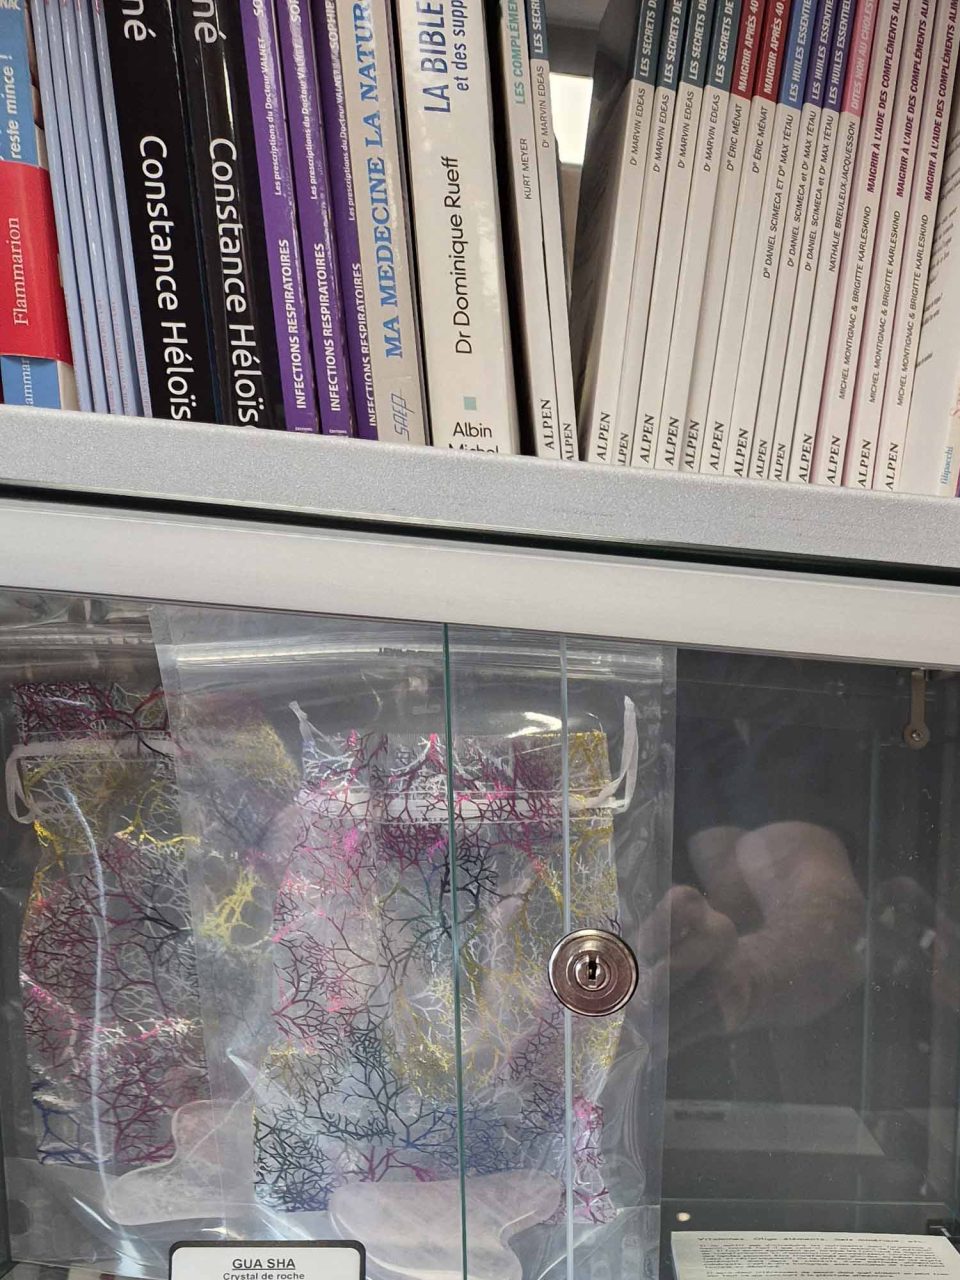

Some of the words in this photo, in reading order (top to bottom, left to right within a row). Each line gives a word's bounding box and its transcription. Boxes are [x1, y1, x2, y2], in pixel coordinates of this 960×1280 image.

[351, 0, 380, 102] NATUR
[417, 0, 448, 76] BIBLE
[883, 13, 898, 86] COMPLÉMENTS
[424, 84, 451, 114] LA
[880, 87, 889, 108] DES
[365, 111, 384, 148] LA
[876, 109, 886, 137] L'AIDE
[440, 156, 464, 210] Rueff
[868, 148, 881, 194] MAIGRIR
[366, 157, 401, 311] MEDECINE
[9, 217, 29, 327] Flammarion
[140, 135, 178, 311] Constance
[161, 319, 195, 421] Héloïs
[210, 138, 247, 313] Constance
[232, 322, 265, 428] Héloïs
[279, 239, 301, 335] RESPIRATOIRES
[444, 215, 473, 327] Dominique
[386, 316, 404, 359] MA
[454, 329, 473, 355] Dr
[291, 336, 308, 410] INFECTIONS
[453, 420, 493, 440] Albin
[596, 411, 612, 462] ALPEN
[664, 416, 680, 466] ALPEN
[885, 441, 900, 491] ALPEN
[232, 1258, 263, 1269] GUA
[267, 1258, 296, 1269] SHA
[261, 1272, 274, 1280] de
[276, 1272, 305, 1280] roche
